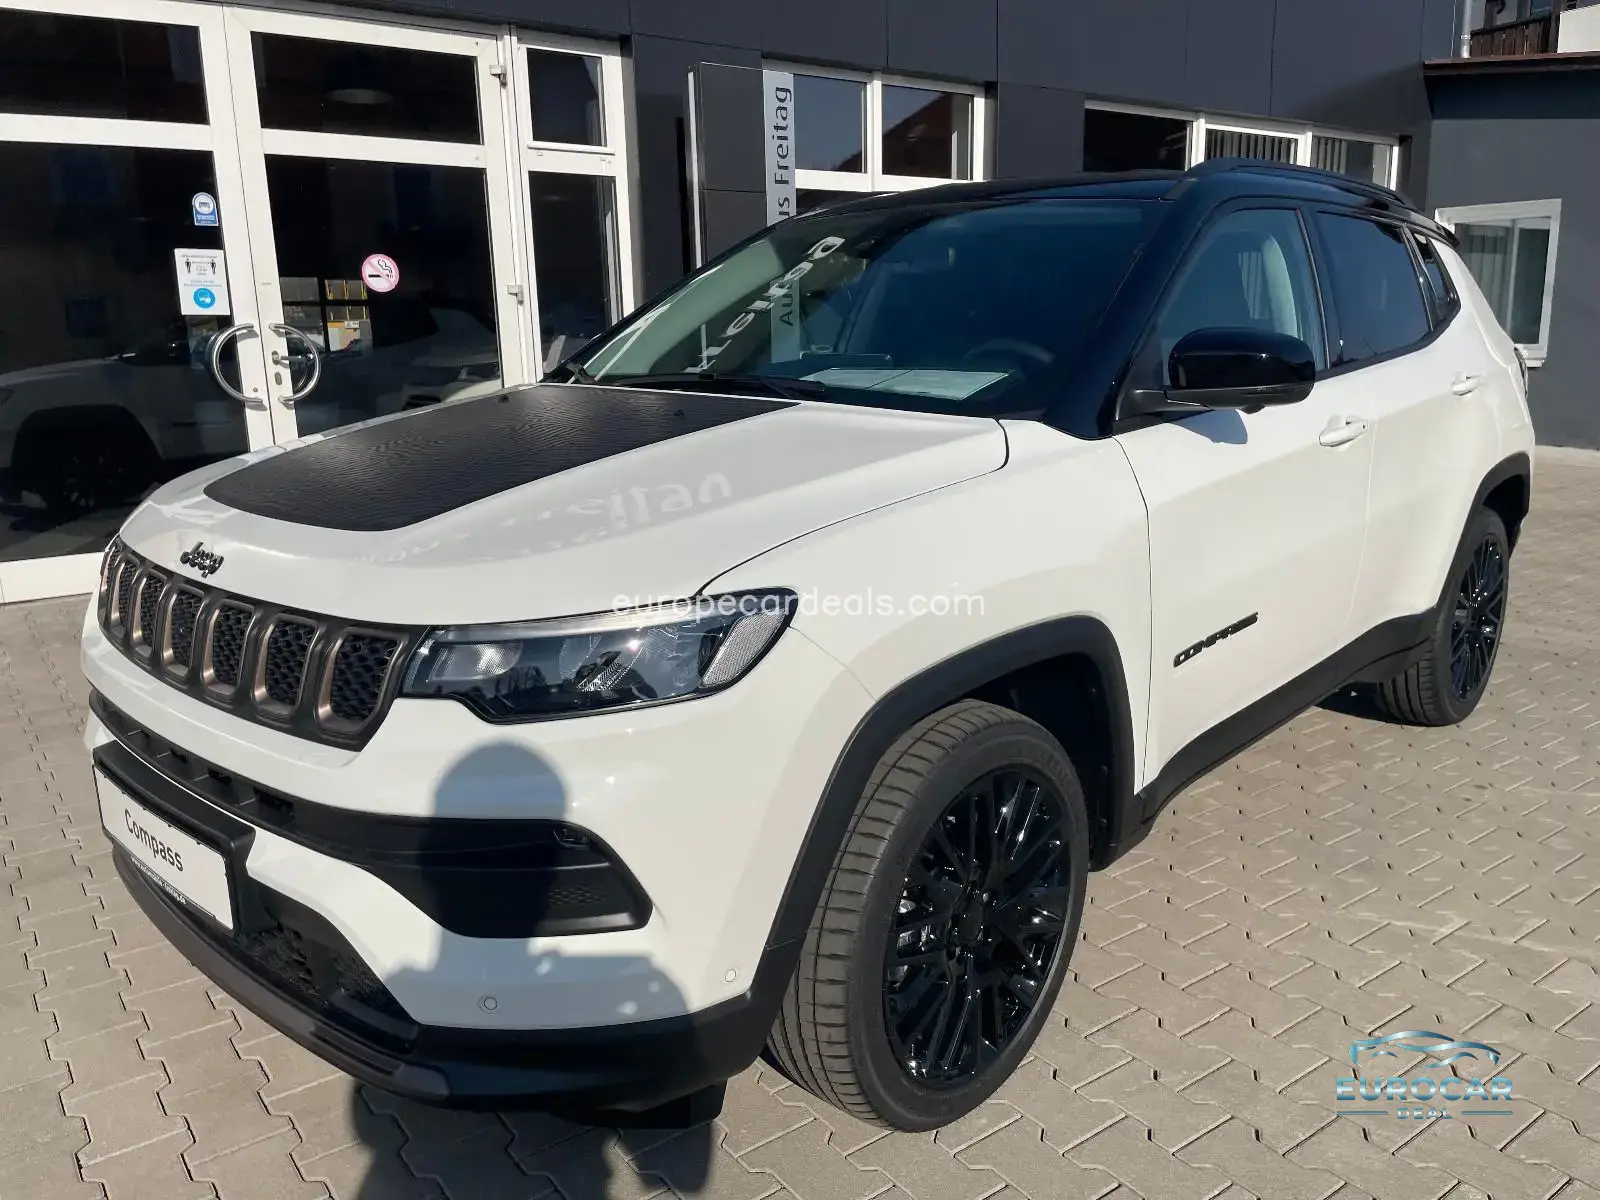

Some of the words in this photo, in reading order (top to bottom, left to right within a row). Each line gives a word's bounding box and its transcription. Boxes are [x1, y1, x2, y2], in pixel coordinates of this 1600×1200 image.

[772, 86, 792, 185] Freitag
[180, 541, 224, 578] Jeep
[125, 808, 184, 872] Compass
